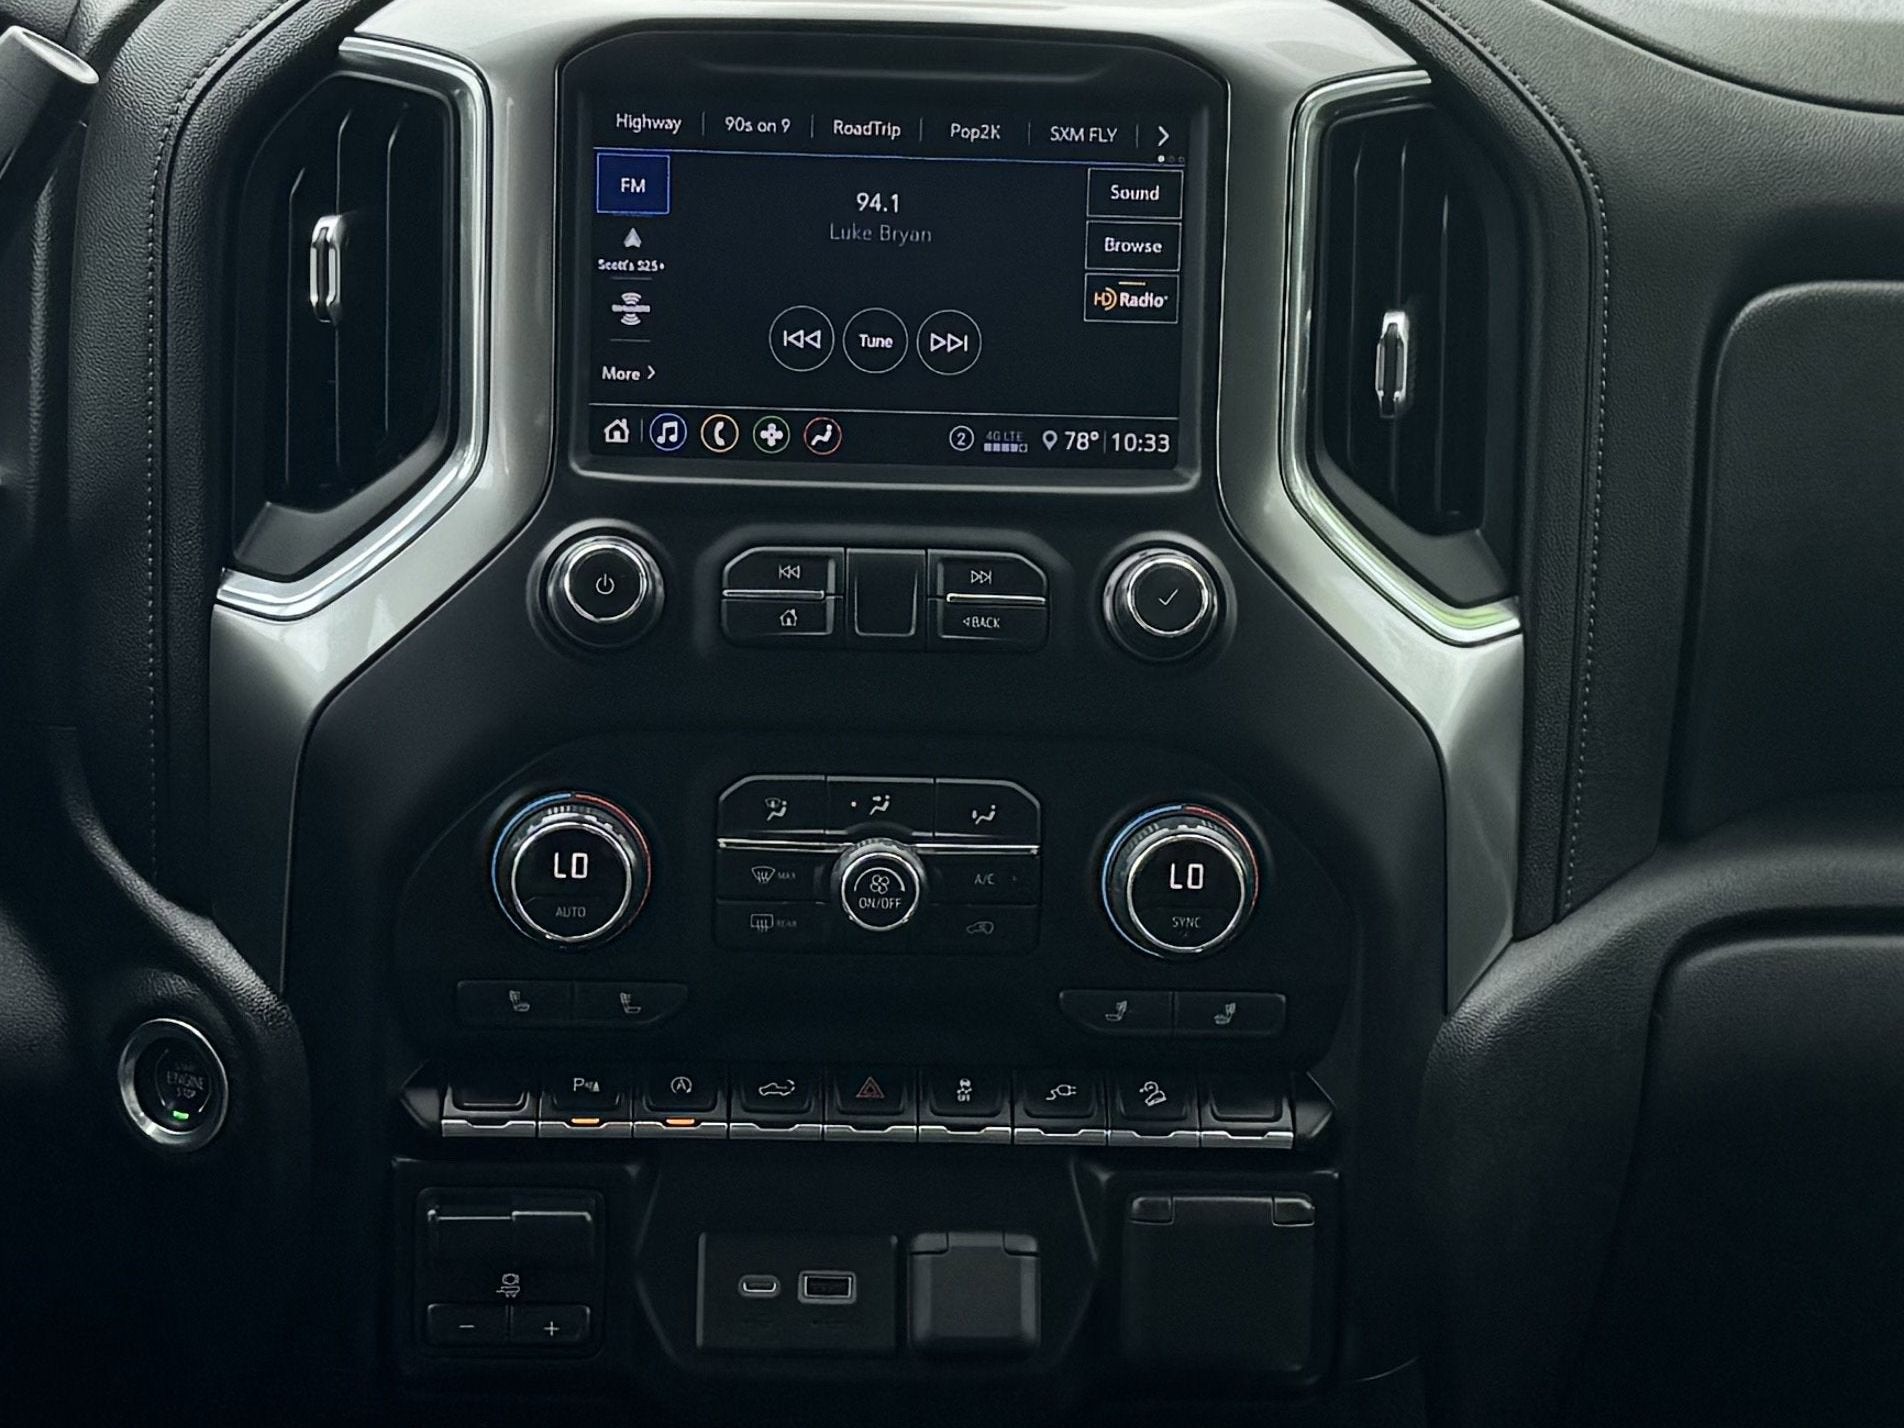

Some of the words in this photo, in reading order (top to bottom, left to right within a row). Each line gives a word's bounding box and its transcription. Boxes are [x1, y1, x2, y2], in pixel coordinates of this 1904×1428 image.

[616, 113, 682, 135] Highway
[725, 116, 752, 134] 90s
[757, 121, 777, 134] on
[781, 118, 791, 134] 9
[833, 119, 901, 141] RoadTrip
[950, 122, 1001, 143] Pop2K
[1050, 125, 1081, 143] SXM
[1083, 127, 1118, 144] FLY
[620, 177, 646, 193] FM
[1110, 183, 1160, 202] Sound
[856, 192, 900, 214] 94.1
[830, 222, 872, 241] Luke
[880, 223, 932, 248] Bryan
[1104, 236, 1163, 254] Browse
[1119, 291, 1161, 309] Radio
[858, 332, 894, 349] Tune
[601, 364, 641, 382] More
[984, 430, 1002, 442] 4G
[1003, 431, 1025, 443] LTE
[1064, 429, 1100, 451] 78°
[1111, 432, 1171, 454] 10:33
[971, 615, 1001, 629] BACK
[553, 852, 589, 880] LO
[974, 873, 995, 886] A/C
[1169, 862, 1204, 891] LO
[858, 896, 902, 910] ON/OFF
[555, 906, 587, 919] AUTO
[1172, 916, 1201, 929] SYNC
